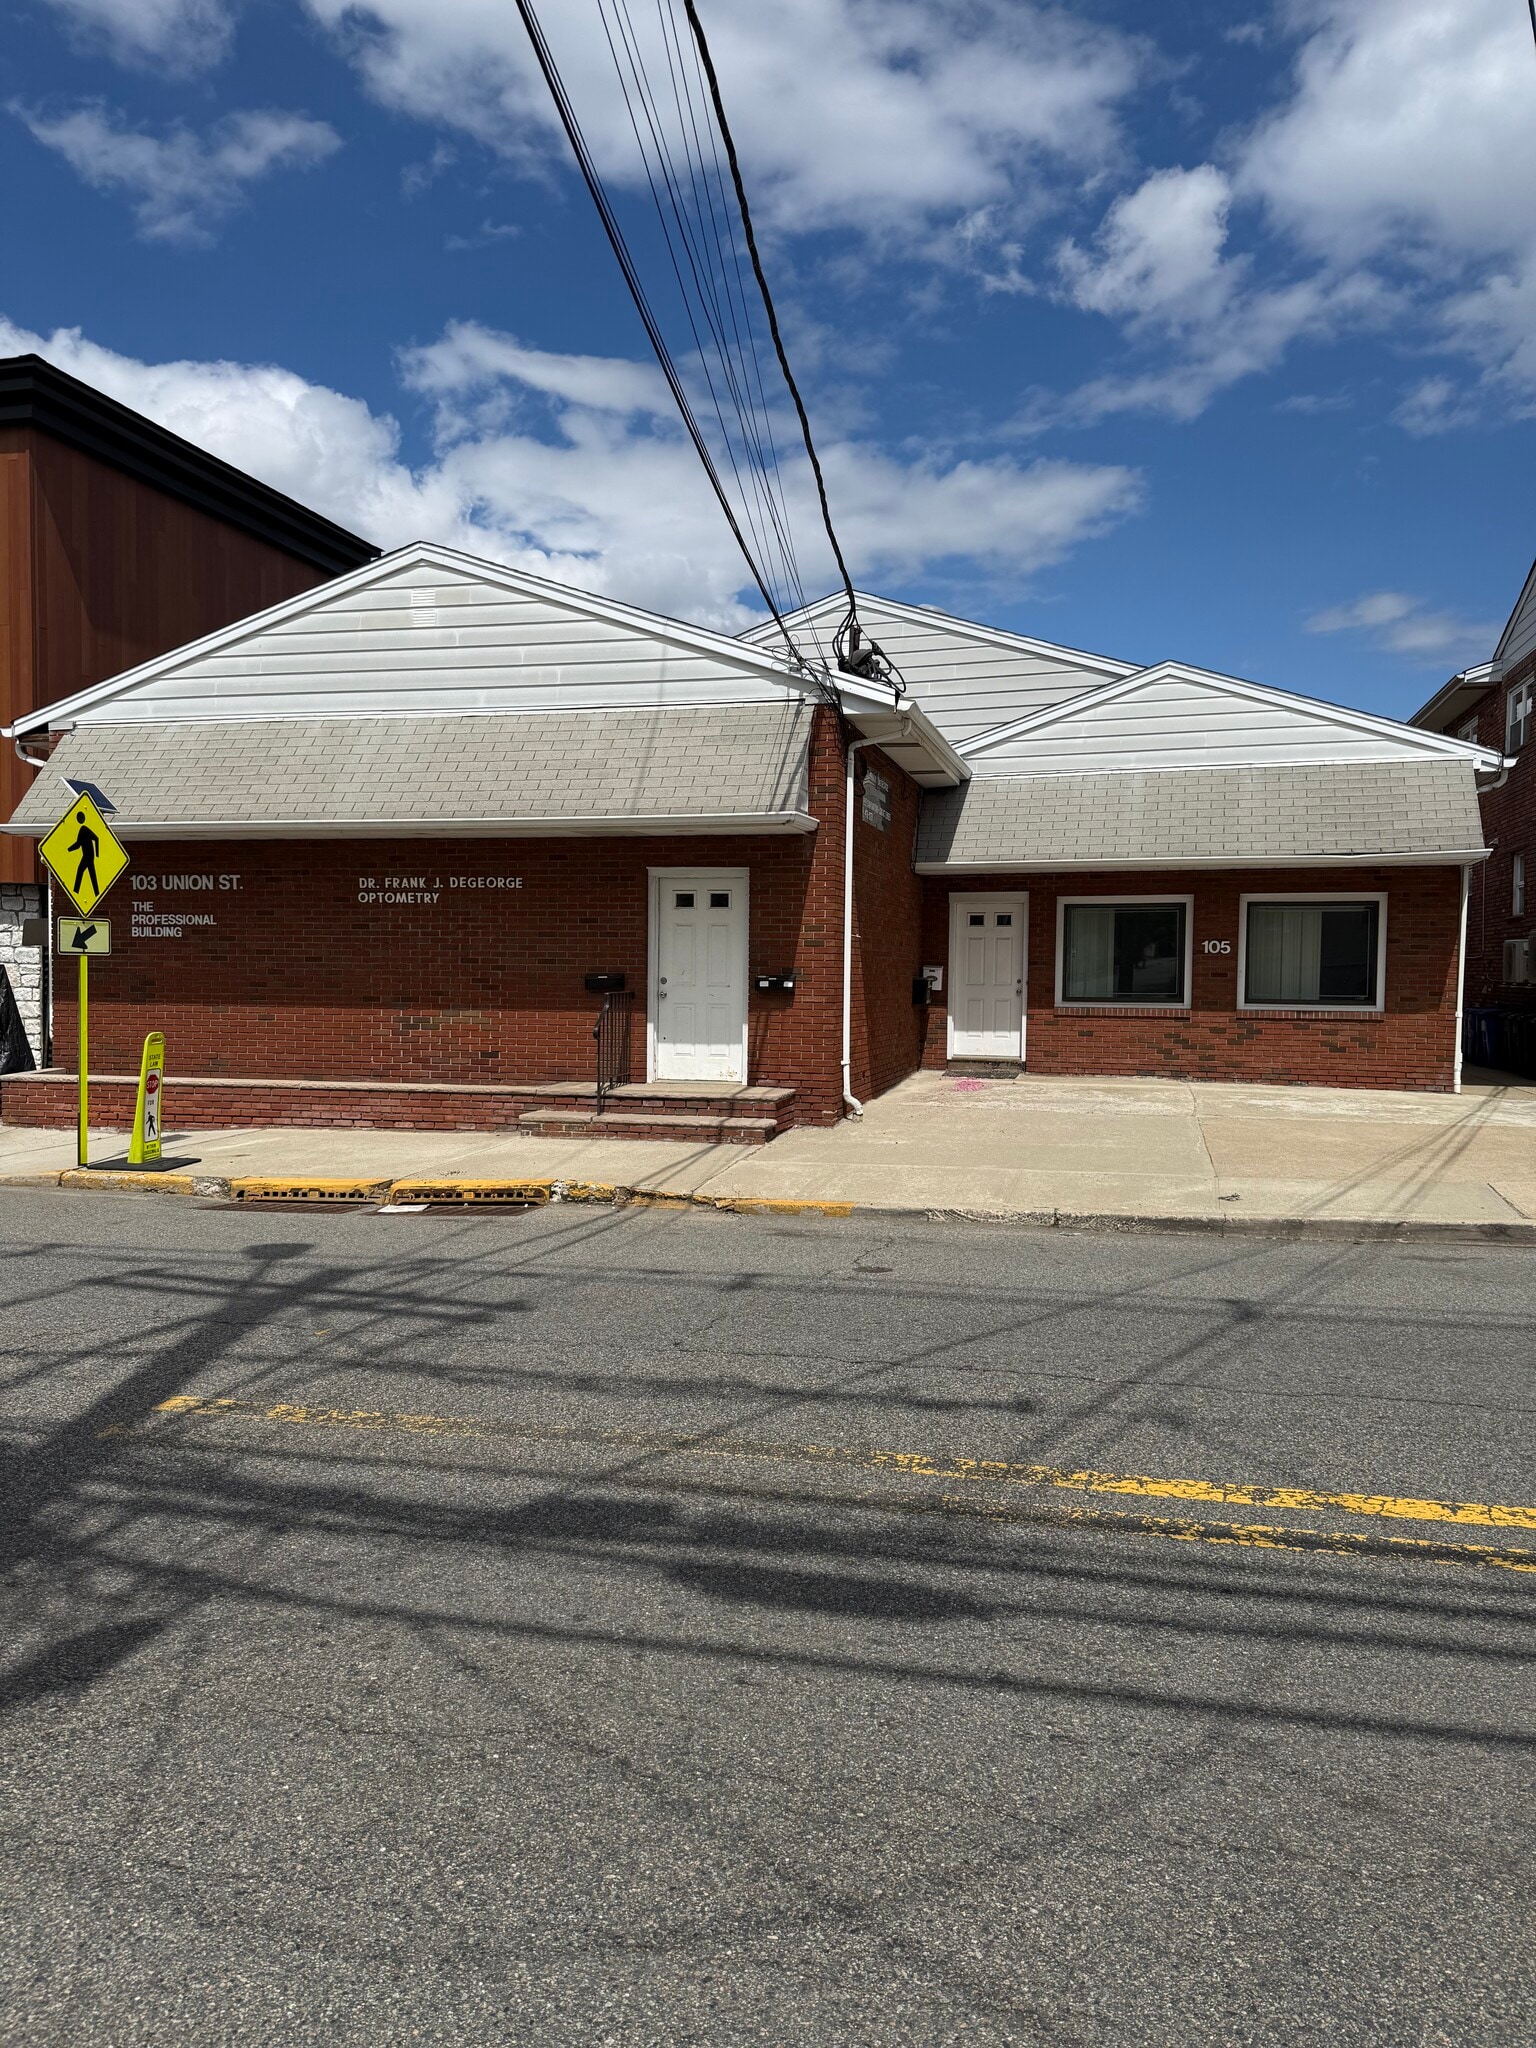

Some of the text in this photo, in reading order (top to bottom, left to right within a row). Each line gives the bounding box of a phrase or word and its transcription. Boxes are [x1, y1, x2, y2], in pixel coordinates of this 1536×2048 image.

[130, 875, 243, 890] 103 UNION ST.
[358, 877, 523, 889] DR. FRANK J. DEGEORGE
[358, 892, 440, 904] OPTOMETRY
[131, 901, 154, 912] THE
[131, 914, 217, 925] PROFESSIONAL
[131, 926, 183, 938] BUILDING
[1201, 940, 1231, 954] 105
[147, 1080, 159, 1089] STOP
